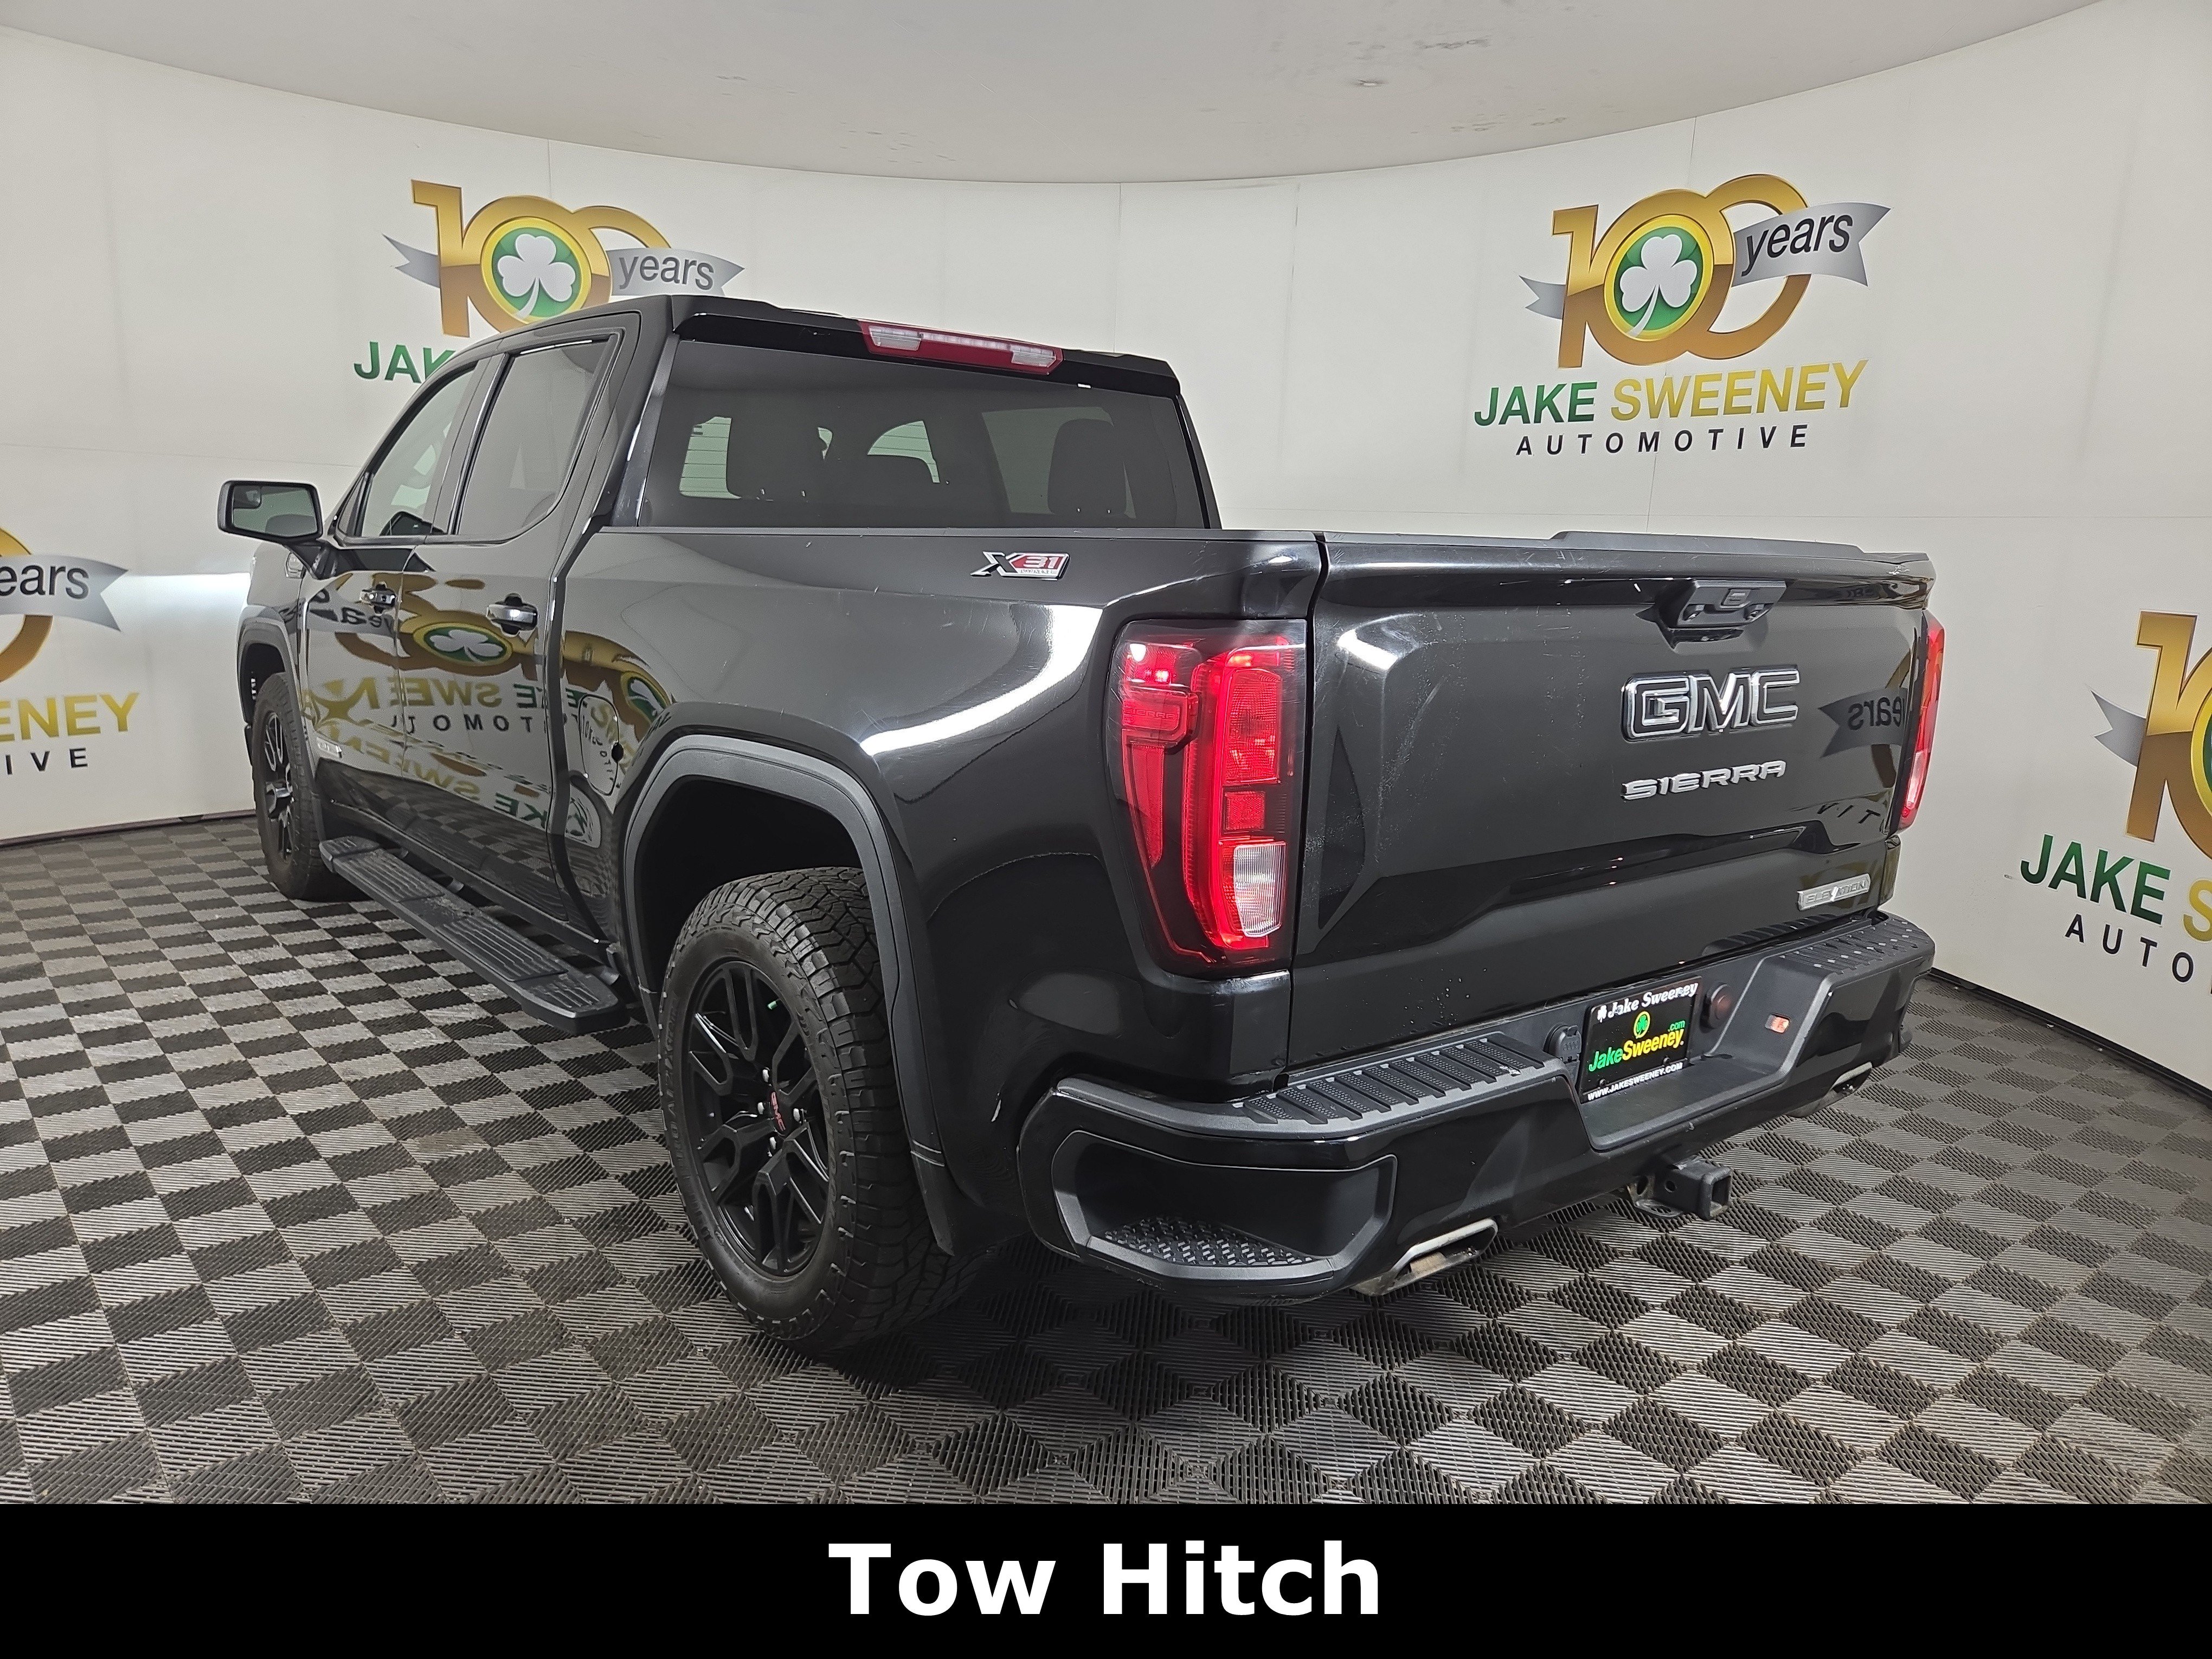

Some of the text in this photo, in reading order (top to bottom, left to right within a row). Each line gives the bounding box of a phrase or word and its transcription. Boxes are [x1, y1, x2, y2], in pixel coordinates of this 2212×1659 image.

[1741, 214, 1853, 277] years
[619, 255, 715, 291] years
[1552, 173, 1811, 369] 100
[354, 342, 455, 383] JAK
[1474, 359, 1869, 427] JAKE SWEENEY
[1516, 424, 1808, 456] AUTOMOTIVE
[0, 564, 89, 600] ears
[1622, 665, 1799, 741] GMC
[5, 748, 88, 775] IVE
[1622, 760, 1786, 801] SIERRA
[2021, 834, 2171, 925] JAKE
[2065, 914, 2212, 994] AUTO
[1608, 982, 1699, 1018] Jake Sweeney
[1587, 1062, 1683, 1101] WWW.JAKESWEENEY.COM
